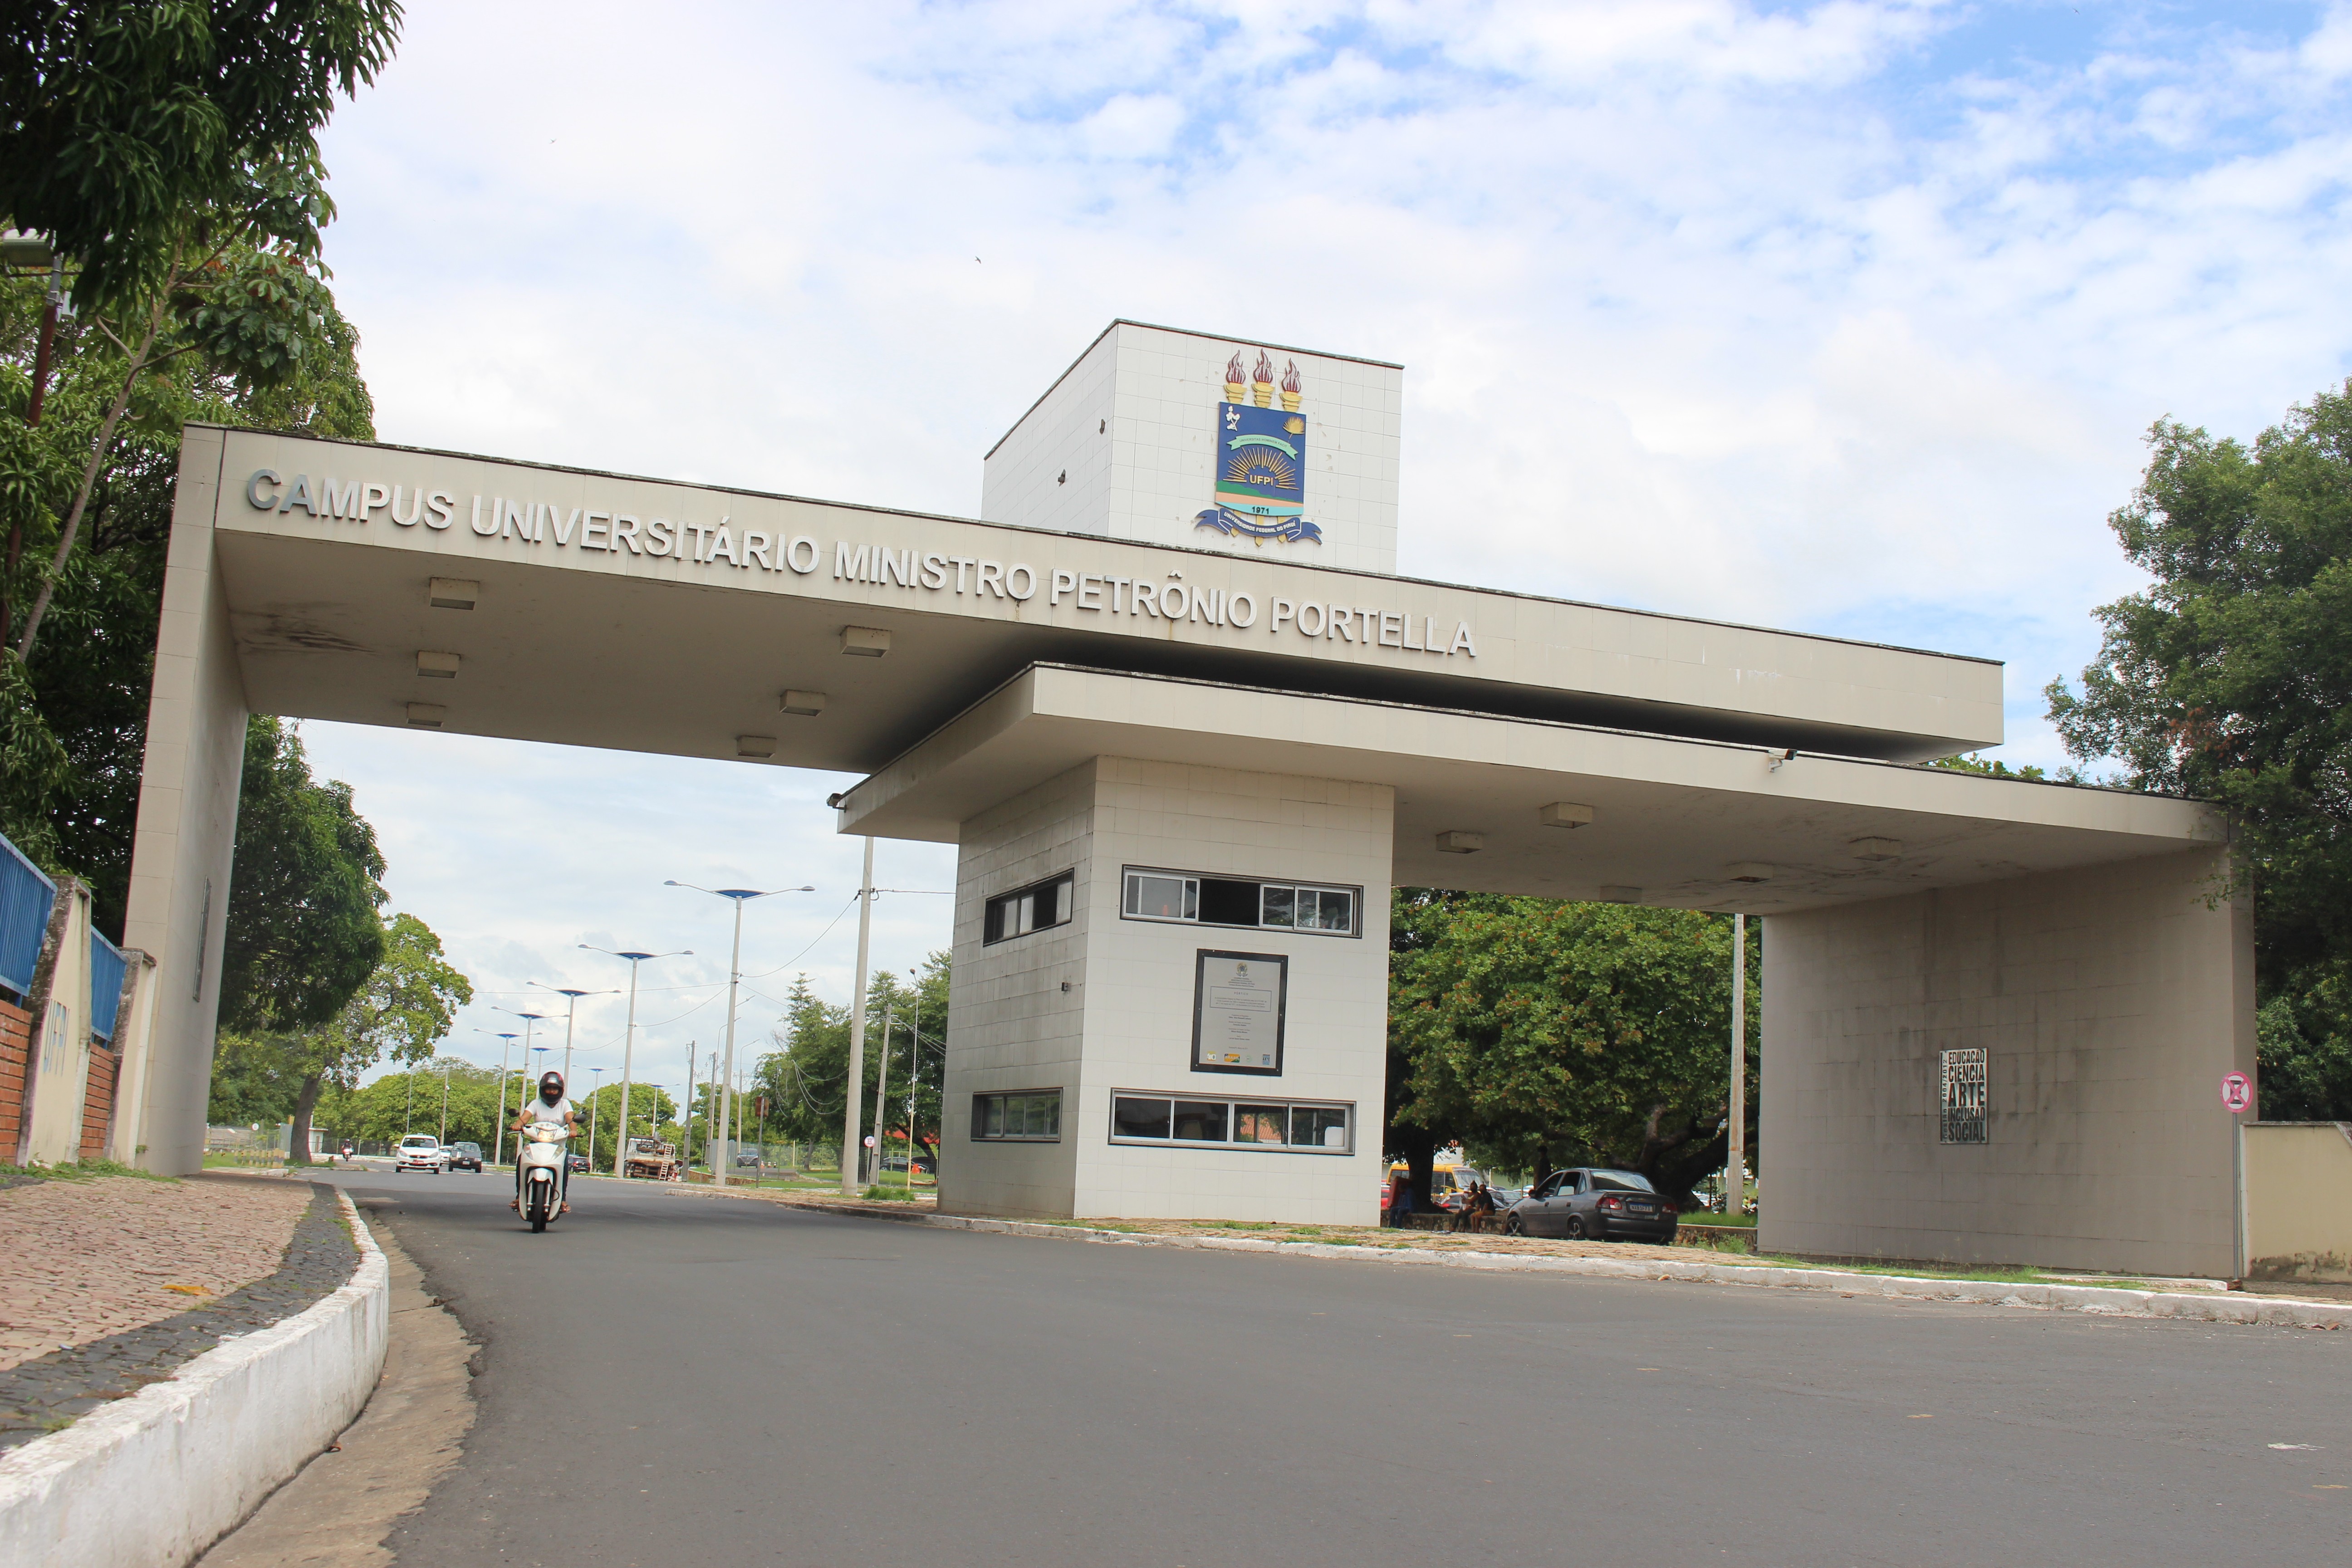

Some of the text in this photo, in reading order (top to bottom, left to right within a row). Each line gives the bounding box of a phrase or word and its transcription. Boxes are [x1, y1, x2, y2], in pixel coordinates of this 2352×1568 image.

[1250, 475, 1274, 486] UFPI
[1252, 506, 1269, 514] 1971
[1224, 511, 1255, 531] UNIVERSIDADE
[247, 469, 1477, 657] CAMPUS UNIVERSITÁRIO MINISTRO PETRÔNIO PORTELLA
[43, 998, 70, 1077] UFPI
[1948, 1082, 1985, 1107] ARTE
[1948, 1107, 1985, 1122] INCLUSÃO
[1948, 1122, 1985, 1141] SOCIAL
